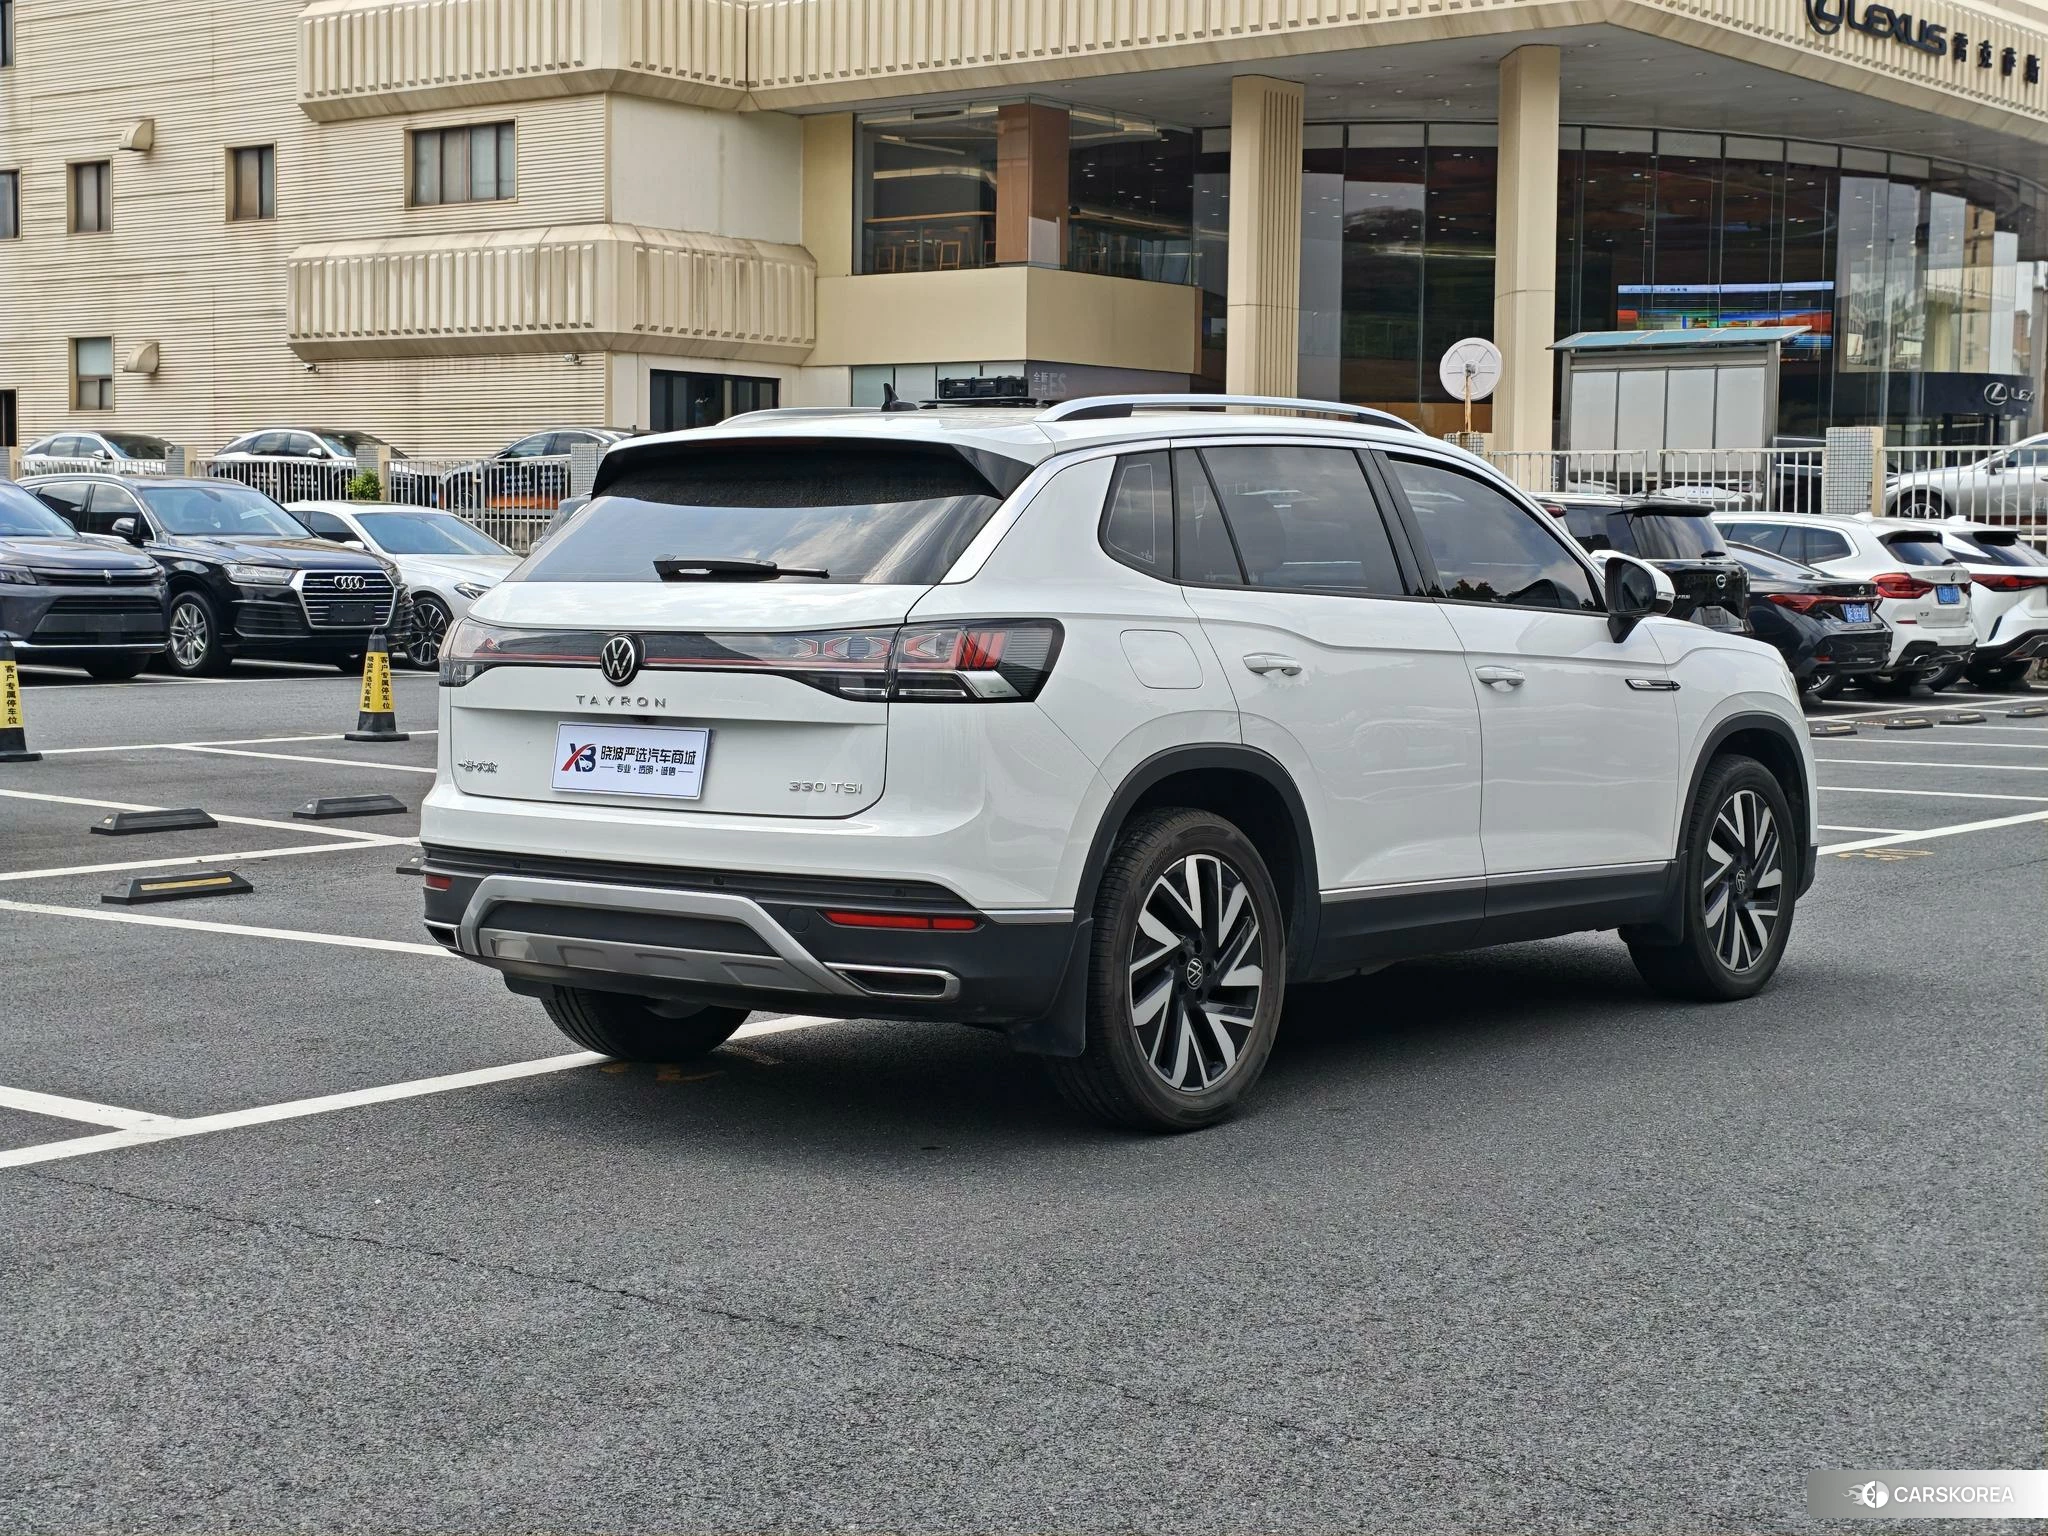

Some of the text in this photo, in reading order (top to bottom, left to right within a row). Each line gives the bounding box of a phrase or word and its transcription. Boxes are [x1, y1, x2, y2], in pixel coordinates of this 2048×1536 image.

[1847, 0, 1948, 56] LEXUS
[5, 664, 18, 725] 客户专属停车位
[575, 694, 667, 708] TAYRON
[600, 745, 697, 766] 晓波严选汽车商城
[789, 781, 863, 795] 330 TSI
